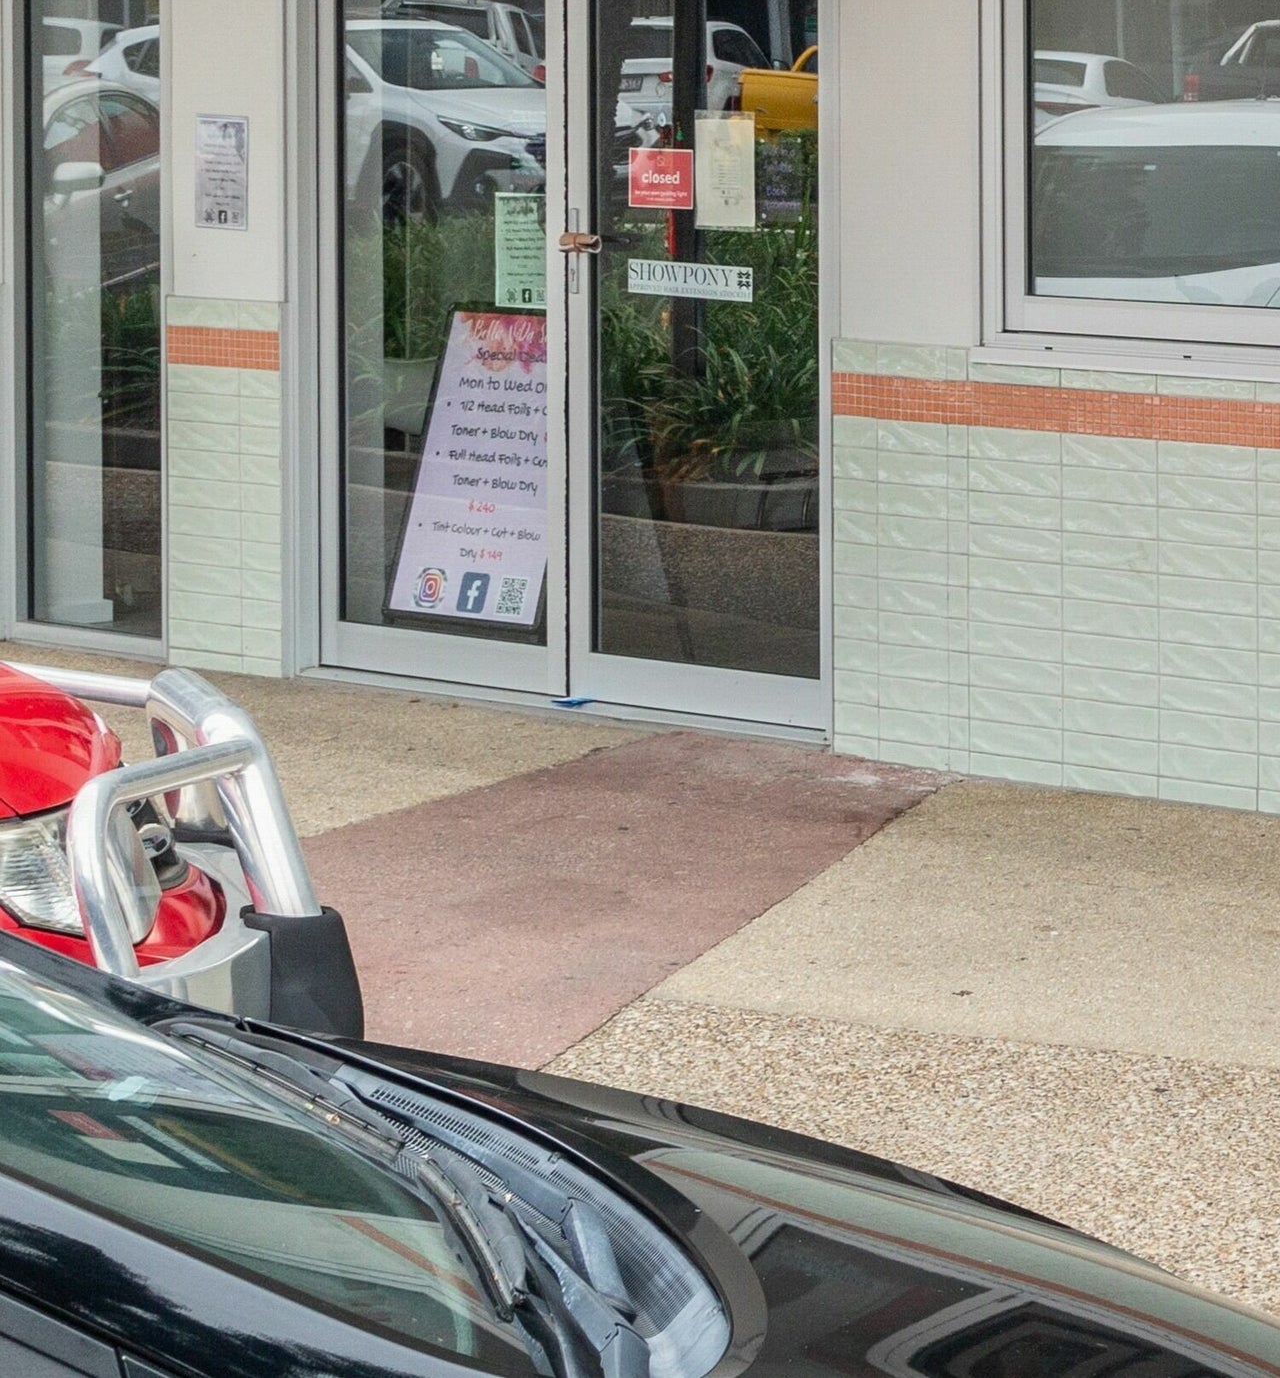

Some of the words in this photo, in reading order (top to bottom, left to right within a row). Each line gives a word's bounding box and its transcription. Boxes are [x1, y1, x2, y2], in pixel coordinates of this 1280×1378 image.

[641, 169, 680, 184] closed
[629, 262, 733, 287] SHOWPONY
[476, 347, 517, 366] Special
[459, 377, 484, 389] Mon
[486, 376, 501, 390] to
[504, 380, 533, 391] Wed
[477, 401, 505, 413] Head
[508, 403, 531, 416] Foils
[451, 424, 480, 437] Toner
[491, 427, 516, 439] Blow
[519, 431, 539, 446] Dry
[448, 450, 466, 461] Full
[469, 450, 497, 463] Head
[498, 453, 522, 467] Foils
[453, 474, 481, 487] Toner
[491, 477, 518, 490] Blow
[519, 480, 539, 497] Dry
[432, 521, 450, 531] Tint
[451, 523, 482, 534] Colour
[491, 526, 508, 538] Cut
[517, 528, 541, 541] Blow
[460, 547, 478, 563] Dry
